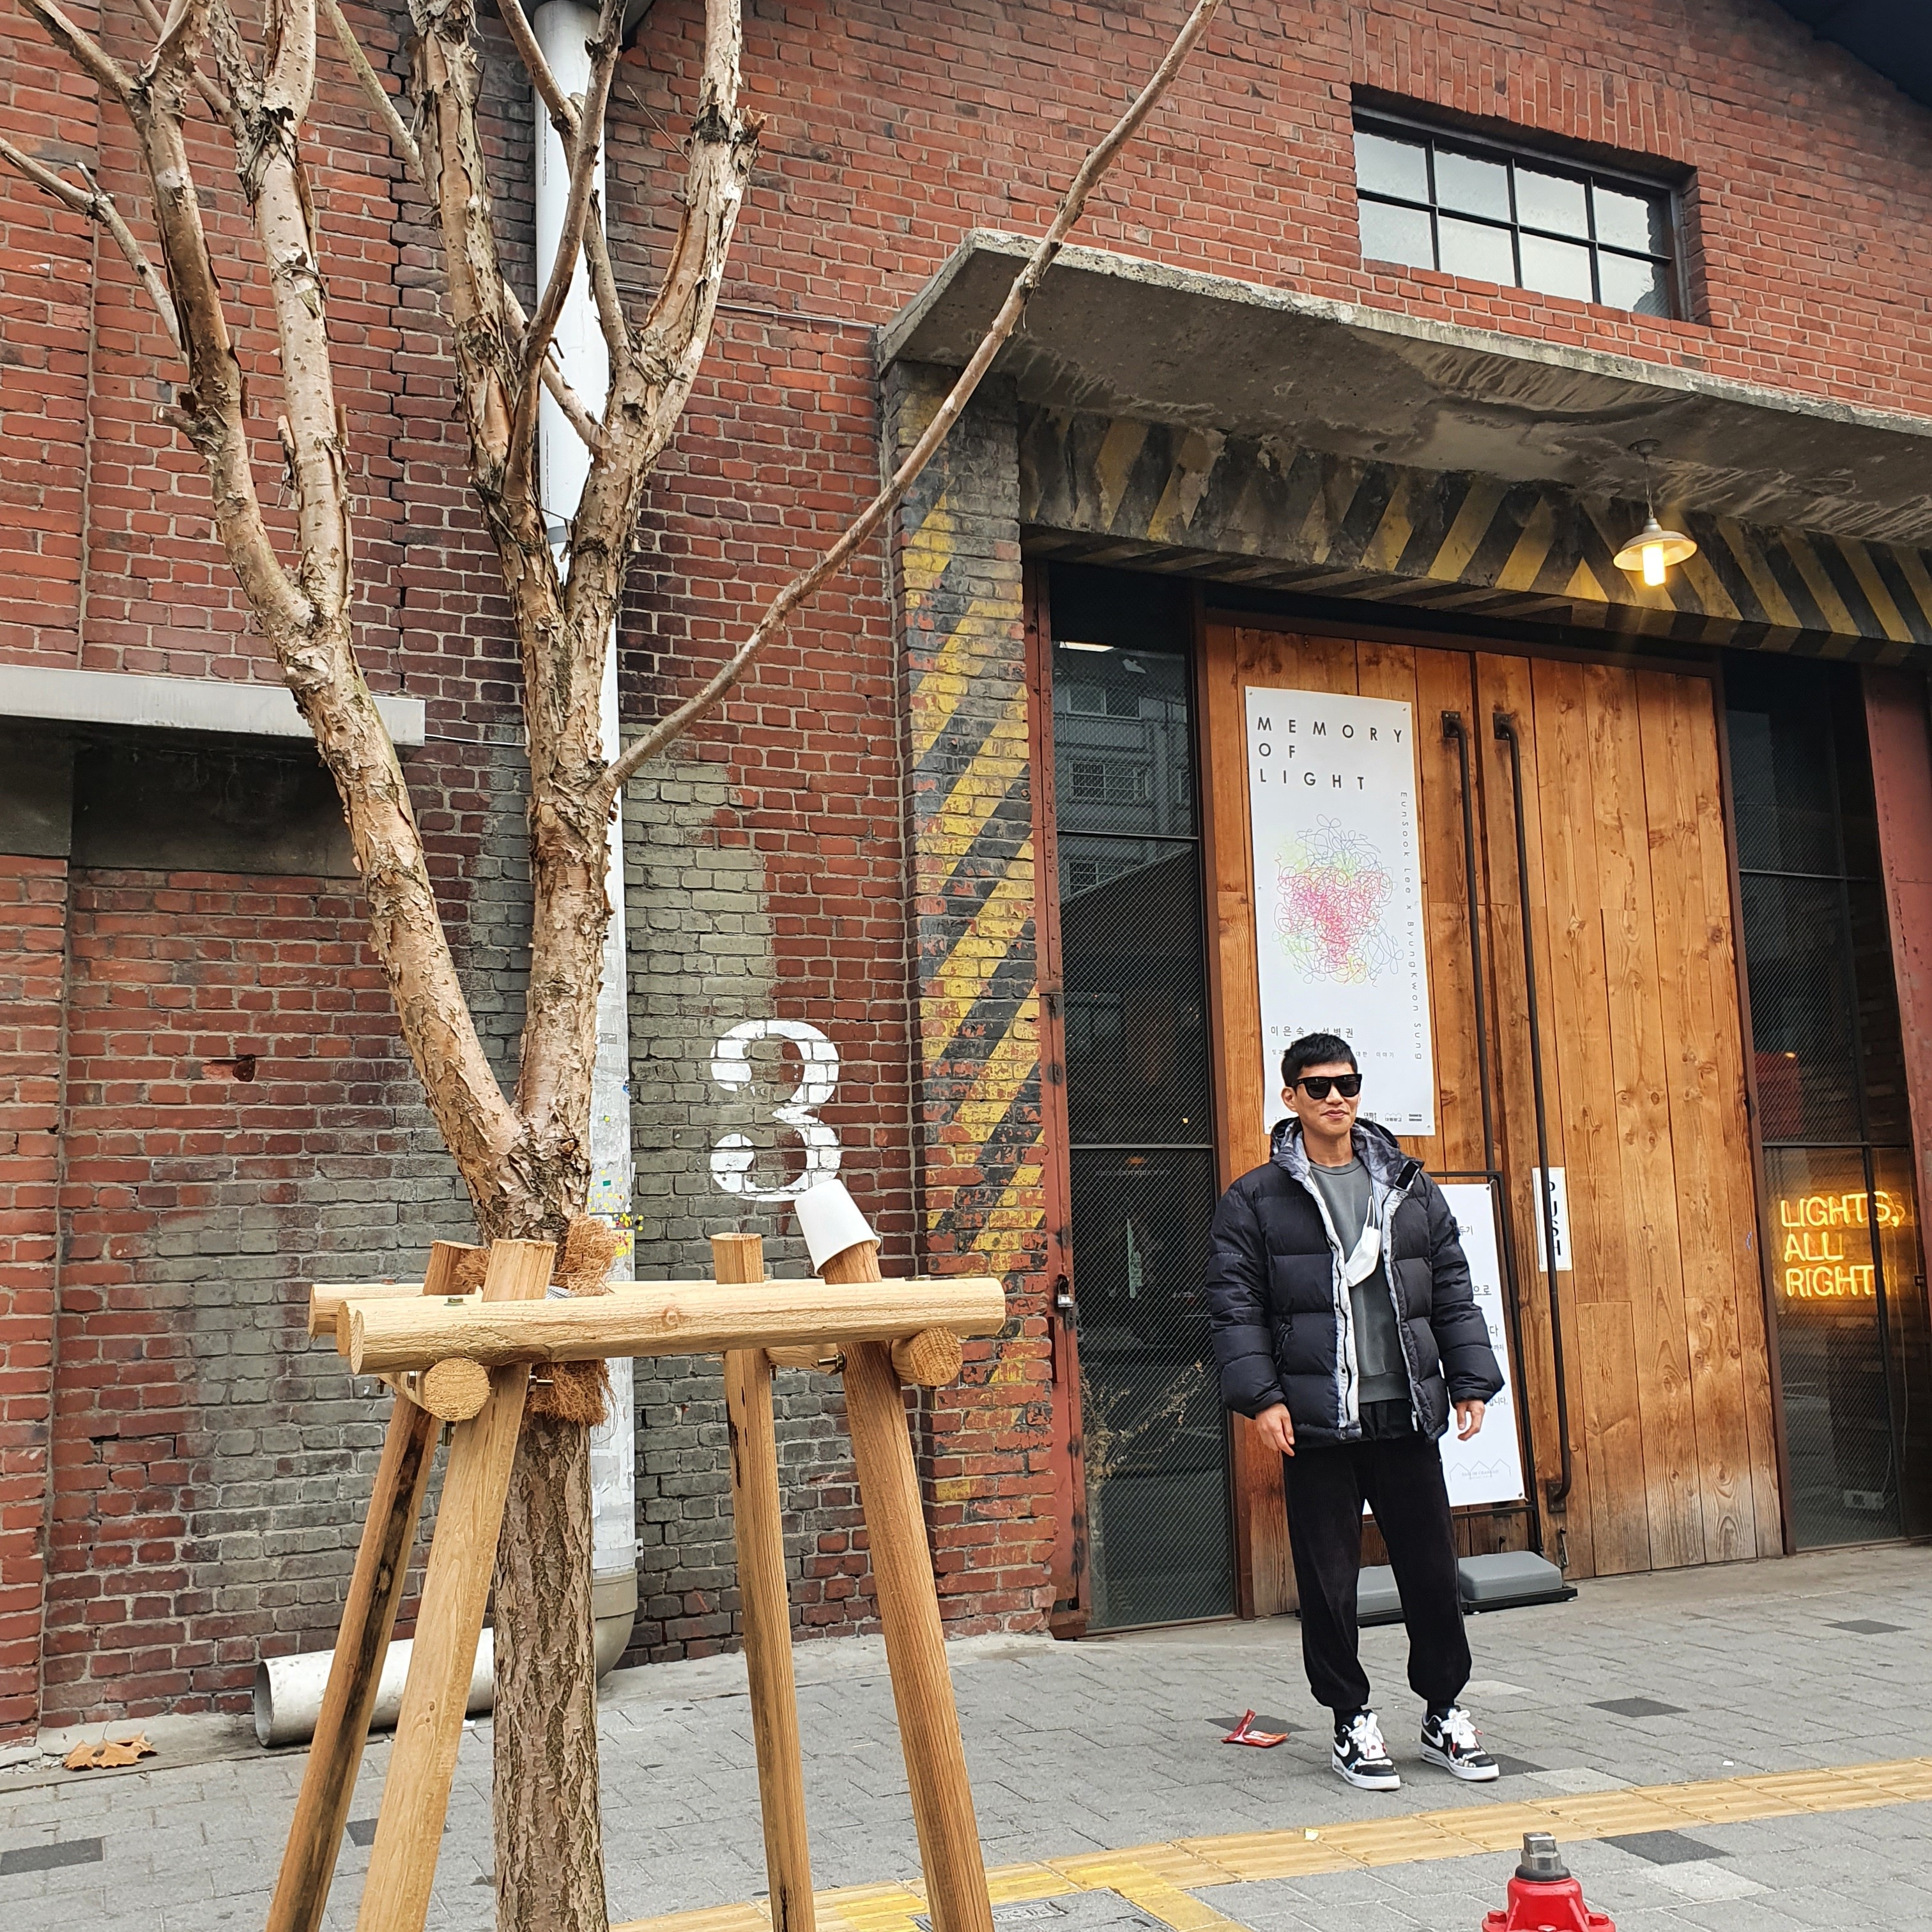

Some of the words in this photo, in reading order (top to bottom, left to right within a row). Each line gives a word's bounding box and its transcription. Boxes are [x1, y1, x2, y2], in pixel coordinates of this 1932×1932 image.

[1257, 716, 1402, 742] MEMORY
[1259, 742, 1296, 758] OF
[1260, 768, 1364, 790] LIGHT
[1271, 1025, 1305, 1037] 이은숙
[1784, 1231, 1844, 1262] ALL
[1785, 1264, 1874, 1298] RIGHT
